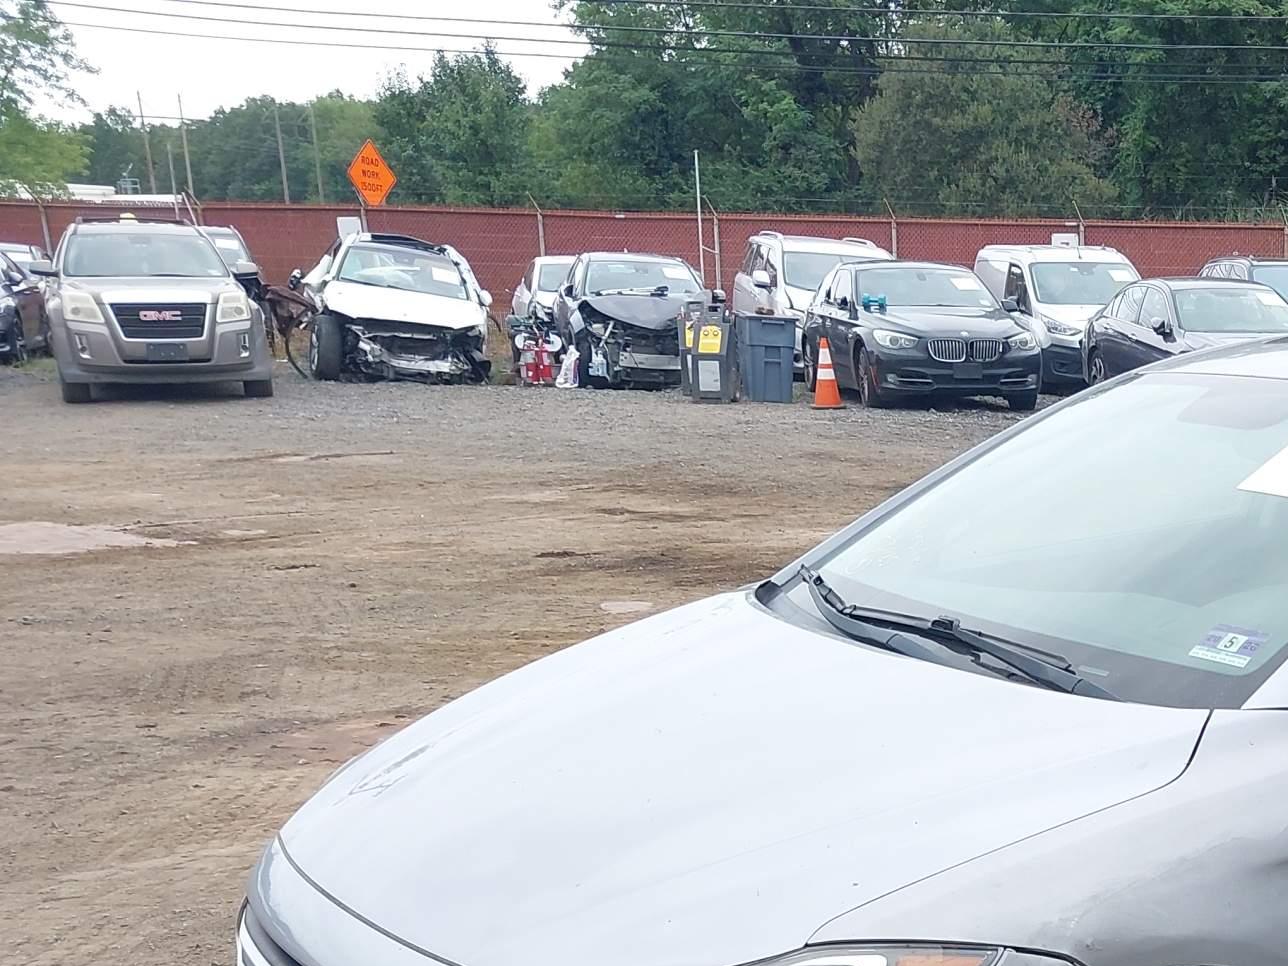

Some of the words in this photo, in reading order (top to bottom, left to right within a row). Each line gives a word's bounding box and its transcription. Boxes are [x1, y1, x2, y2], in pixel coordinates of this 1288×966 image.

[361, 156, 379, 167] ROAD
[362, 169, 381, 180] WORK
[139, 310, 182, 321] GMC
[1224, 636, 1238, 648] 5
